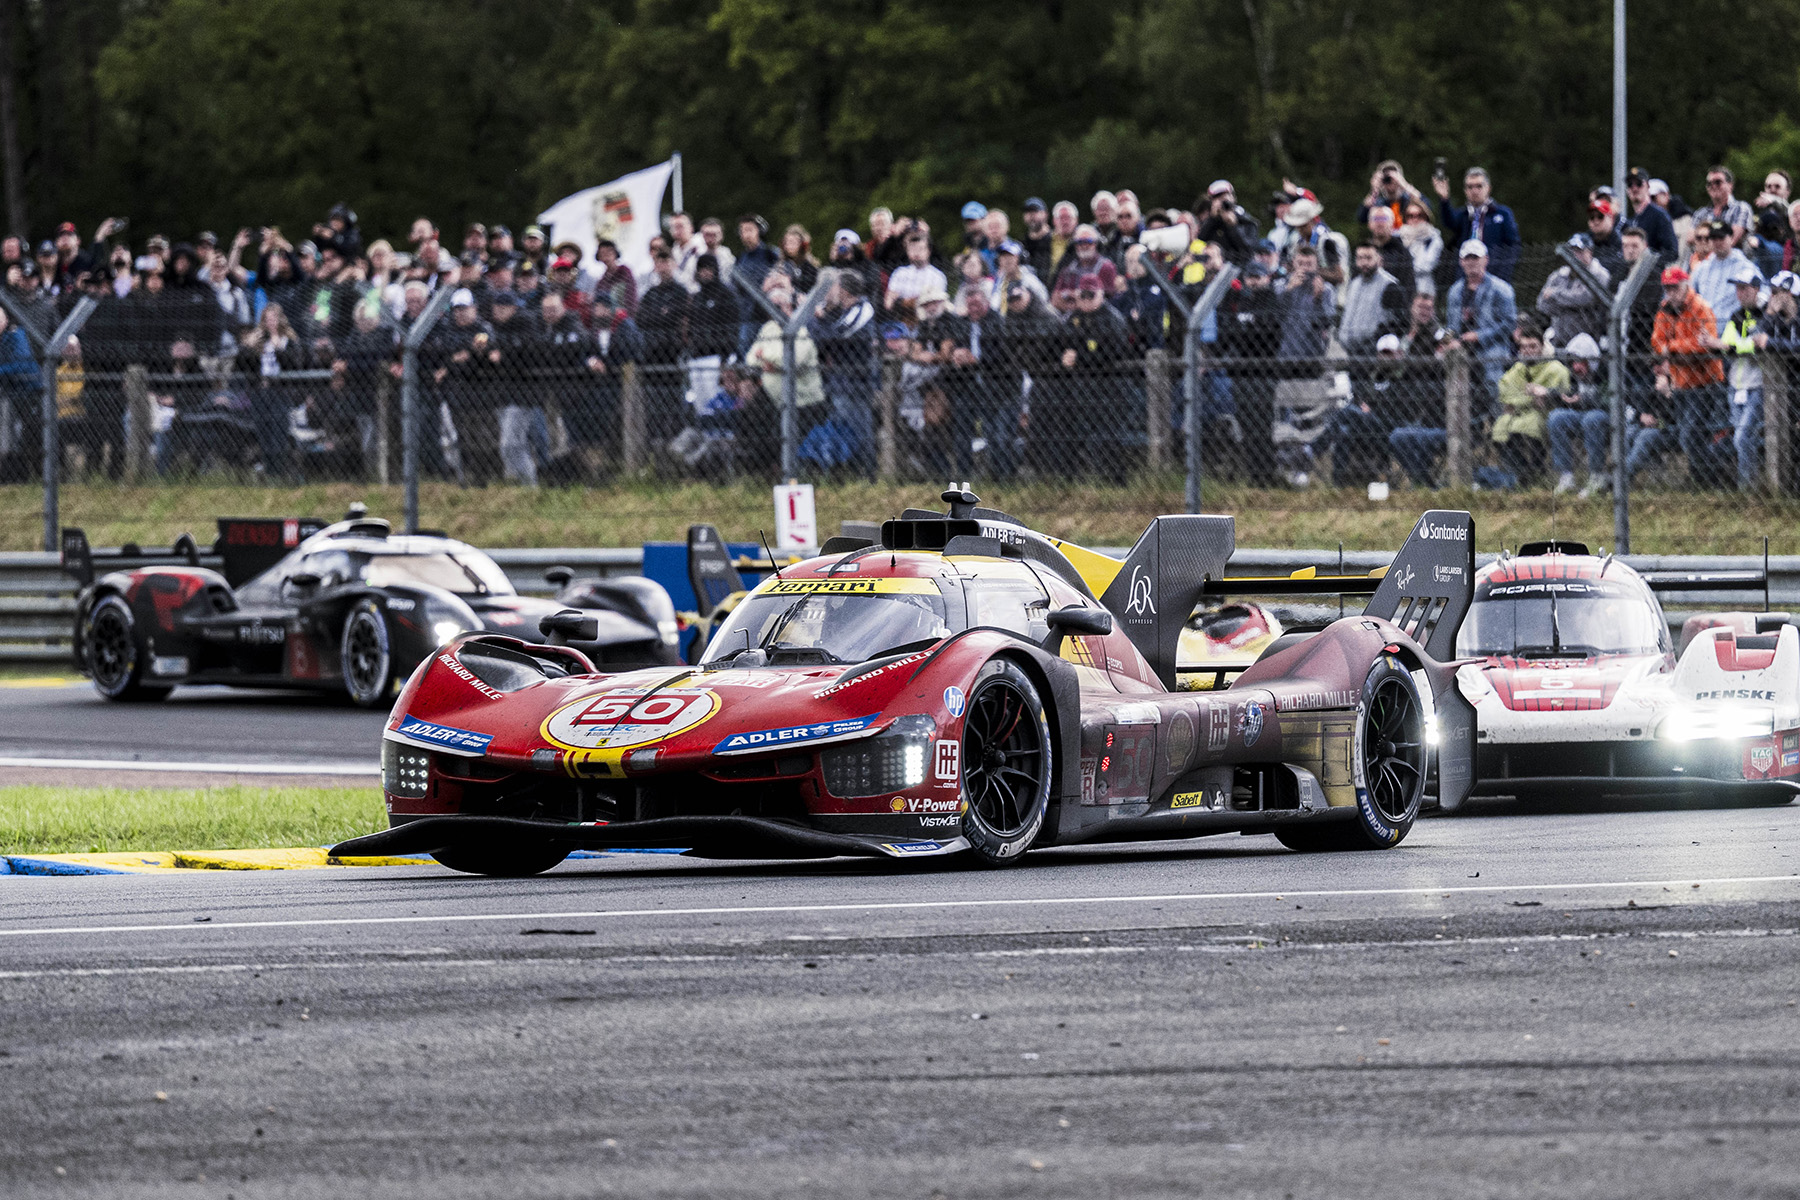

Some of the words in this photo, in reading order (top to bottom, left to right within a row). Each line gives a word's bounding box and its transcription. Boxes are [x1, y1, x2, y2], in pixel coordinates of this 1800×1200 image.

[1430, 523, 1468, 540] Santander
[765, 579, 882, 593] Ferrari
[1489, 583, 1620, 596] PORSCHE
[438, 653, 473, 681] RICHARD
[469, 679, 503, 701] MILLE
[813, 669, 884, 700] RICHARD
[886, 650, 935, 671] MILLE
[948, 687, 963, 716] hp
[1281, 692, 1322, 710] RICHARD
[1324, 690, 1356, 706] MILLE
[1696, 689, 1776, 701] PENSKE
[580, 697, 685, 720] 50
[400, 723, 456, 741] ADLER
[727, 728, 808, 747] ADLER
[833, 725, 864, 733] GROUP
[1753, 748, 1772, 758] TAG
[907, 798, 959, 812] V-Power
[1175, 794, 1199, 806] Sabelt
[1360, 794, 1389, 838] MICHELIN
[905, 843, 937, 852] MICHELIN
